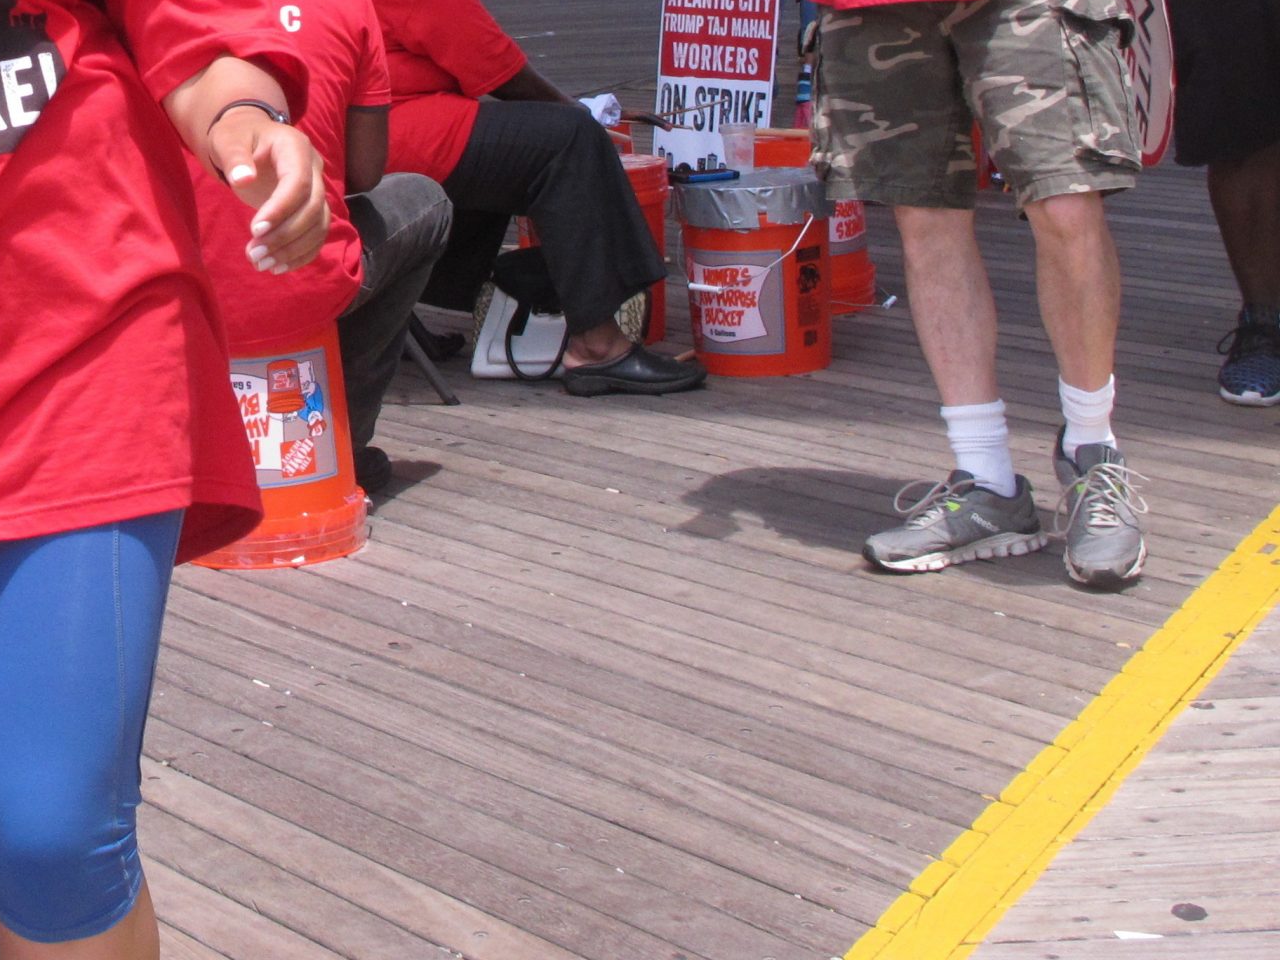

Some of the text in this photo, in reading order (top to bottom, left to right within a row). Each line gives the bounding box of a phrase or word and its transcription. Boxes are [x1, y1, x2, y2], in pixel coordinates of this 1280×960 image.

[664, 13, 772, 39] TRUMP TAJ MAHAL
[673, 41, 759, 75] WORKERS
[660, 82, 766, 132] ON STRIKE
[704, 307, 745, 327] BUCKET
